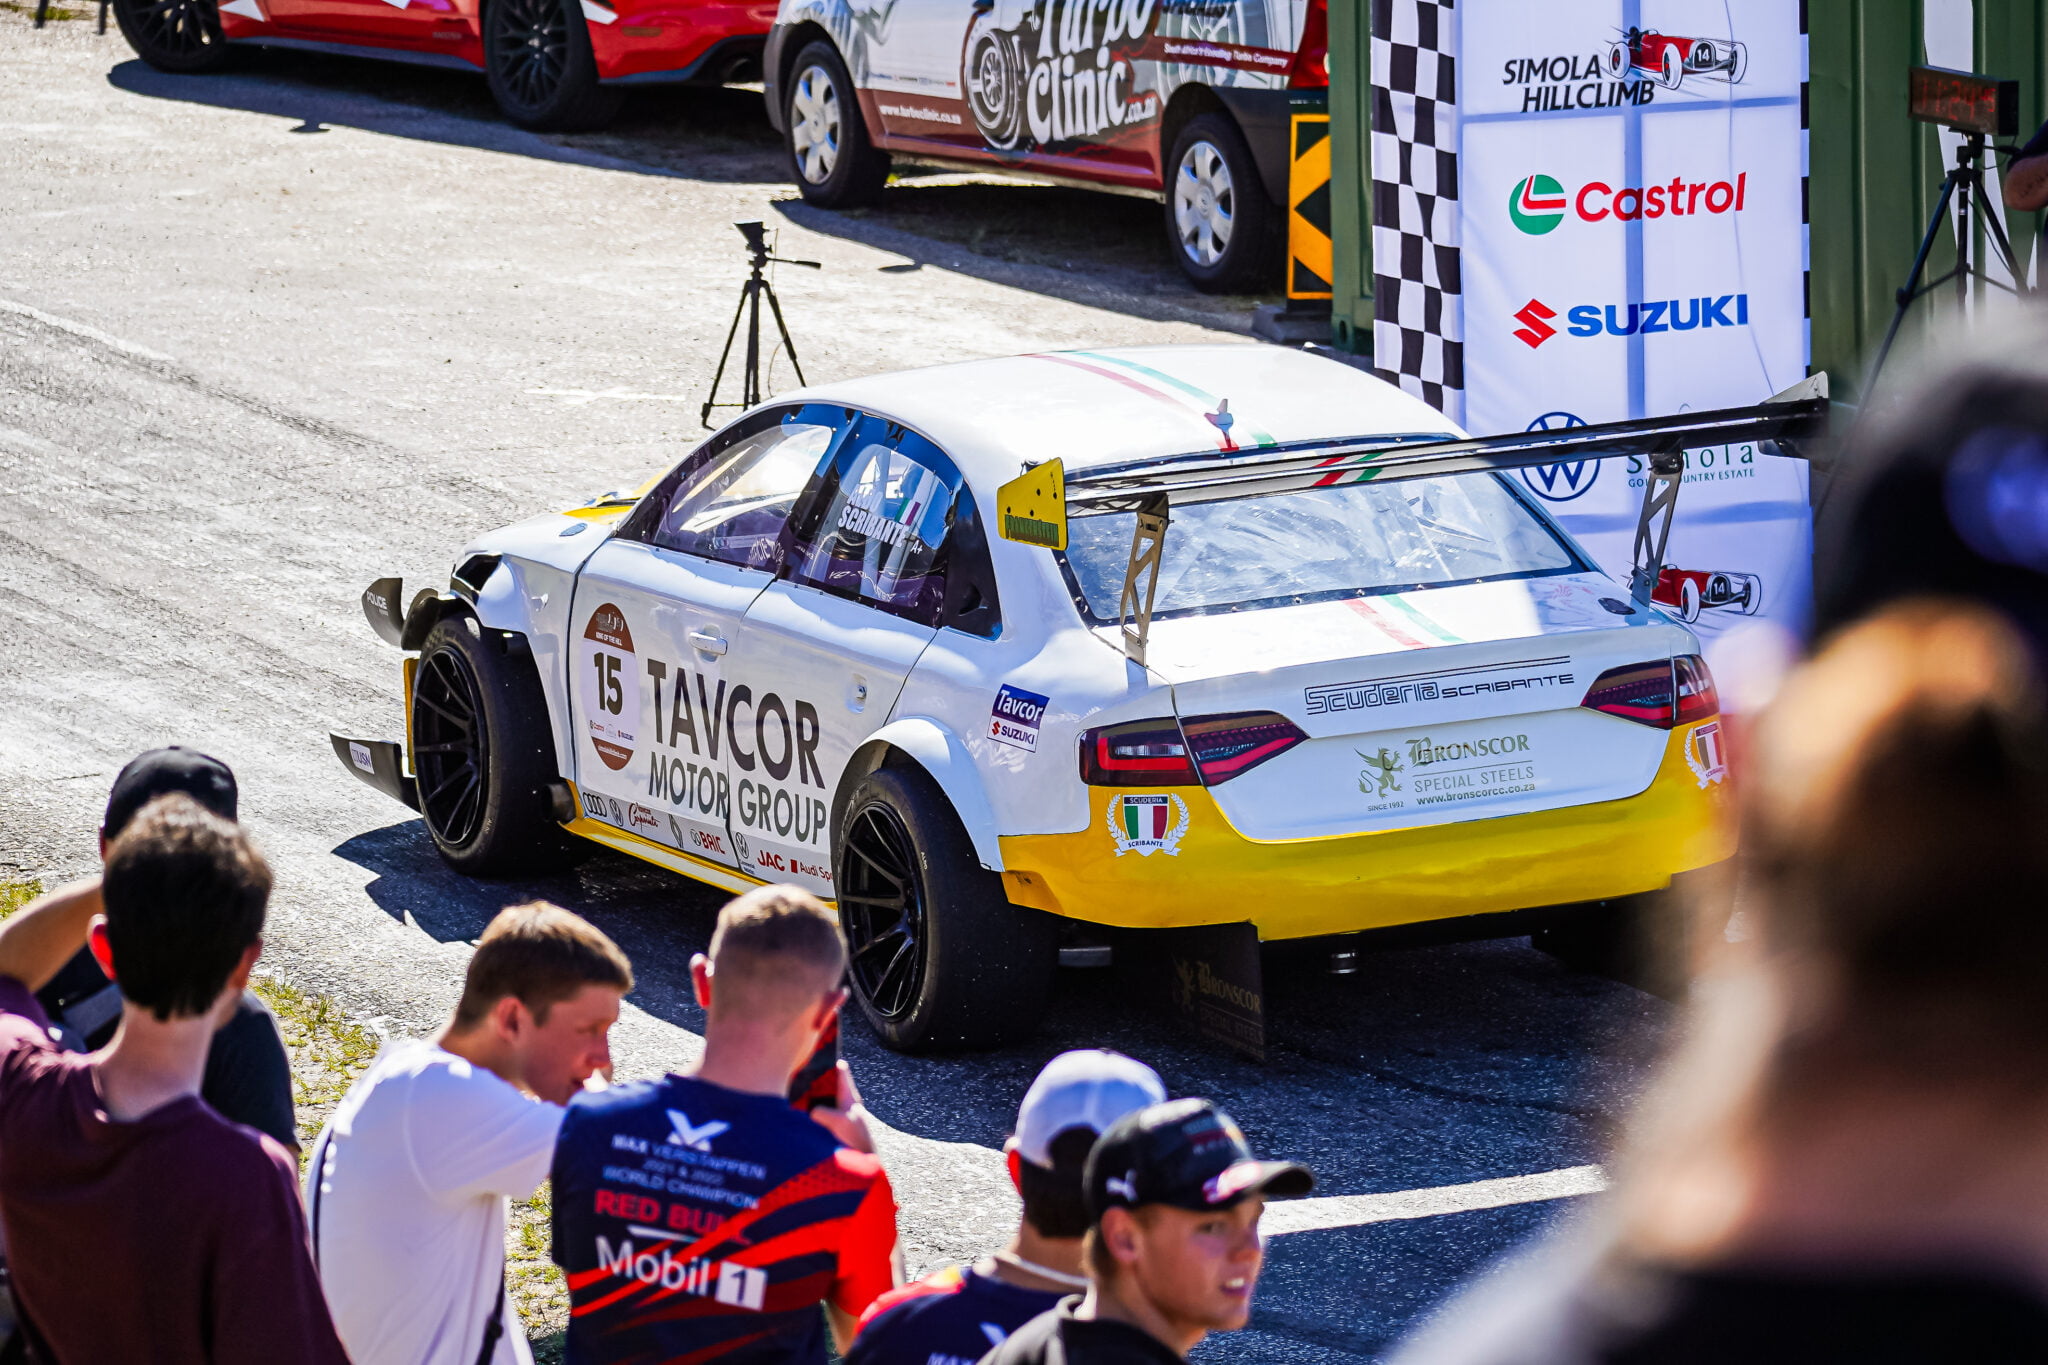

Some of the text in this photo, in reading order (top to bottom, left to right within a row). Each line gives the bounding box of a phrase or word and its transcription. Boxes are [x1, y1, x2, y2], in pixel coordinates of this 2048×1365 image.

[1696, 49, 1711, 62] 14
[1502, 54, 1602, 85] SIMOLA
[1520, 80, 1655, 113] HILLCLIMB
[1576, 171, 1747, 223] Castrol
[1567, 293, 1748, 338] SUZUKI
[1718, 468, 1755, 480] ESTATE
[838, 506, 911, 548] SCRIBANTE
[366, 590, 388, 610] POLICE
[1713, 583, 1725, 594] 14
[594, 652, 623, 715] 15
[1441, 673, 1575, 699] SCRIBANTE
[996, 688, 1044, 722] Tavcor
[648, 658, 826, 790] TAVCOR
[1001, 724, 1035, 745] SUZUKI
[1414, 766, 1535, 793] SPECIAL STEELS
[648, 751, 729, 820] MOTOR
[738, 778, 827, 845] GROUP
[1367, 800, 1405, 812] SINCE 1992
[1416, 782, 1536, 805] www.bronscorcc.co.za
[699, 831, 726, 854] BAIC
[1128, 840, 1163, 848] SCRIBANTE
[757, 850, 785, 872] JAC
[800, 861, 819, 877] Audi
[602, 1164, 666, 1190] WORLD
[594, 1189, 660, 1223] RED
[595, 1235, 749, 1306] Mobil 1
